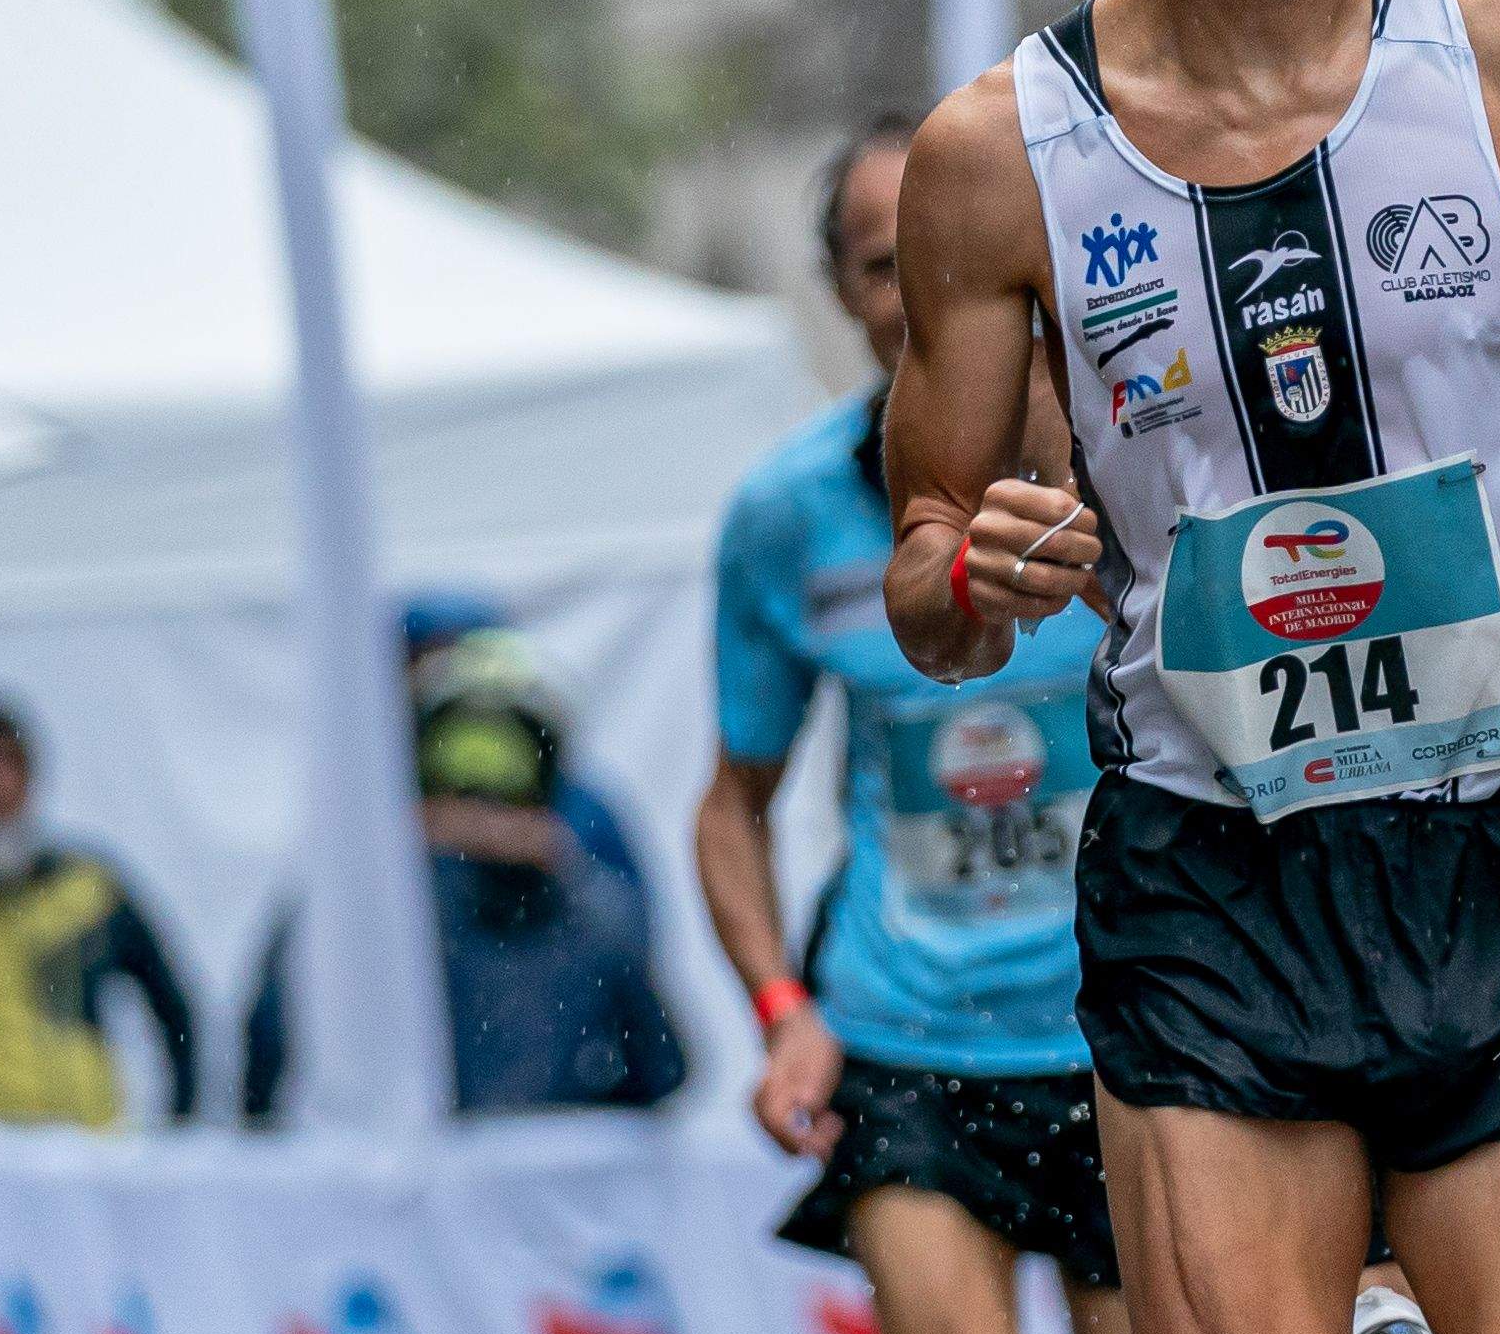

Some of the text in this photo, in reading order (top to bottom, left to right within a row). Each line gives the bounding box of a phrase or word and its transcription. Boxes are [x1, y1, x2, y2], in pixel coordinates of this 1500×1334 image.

[1381, 269, 1491, 292] CLUB ATLETISMO
[1086, 277, 1165, 311] Extremadura
[1403, 284, 1476, 302] BADAJOZ
[1145, 311, 1154, 321] la
[1242, 283, 1326, 329] rasán
[1270, 565, 1358, 586] TotalEnergies
[1295, 591, 1337, 606] MILLA
[1268, 600, 1371, 626] INTERNACIONAL
[1284, 613, 1356, 634] DE MADRID
[1260, 635, 1420, 753] 214
[1336, 748, 1384, 767] MILLA
[1337, 761, 1392, 781] URBANA
